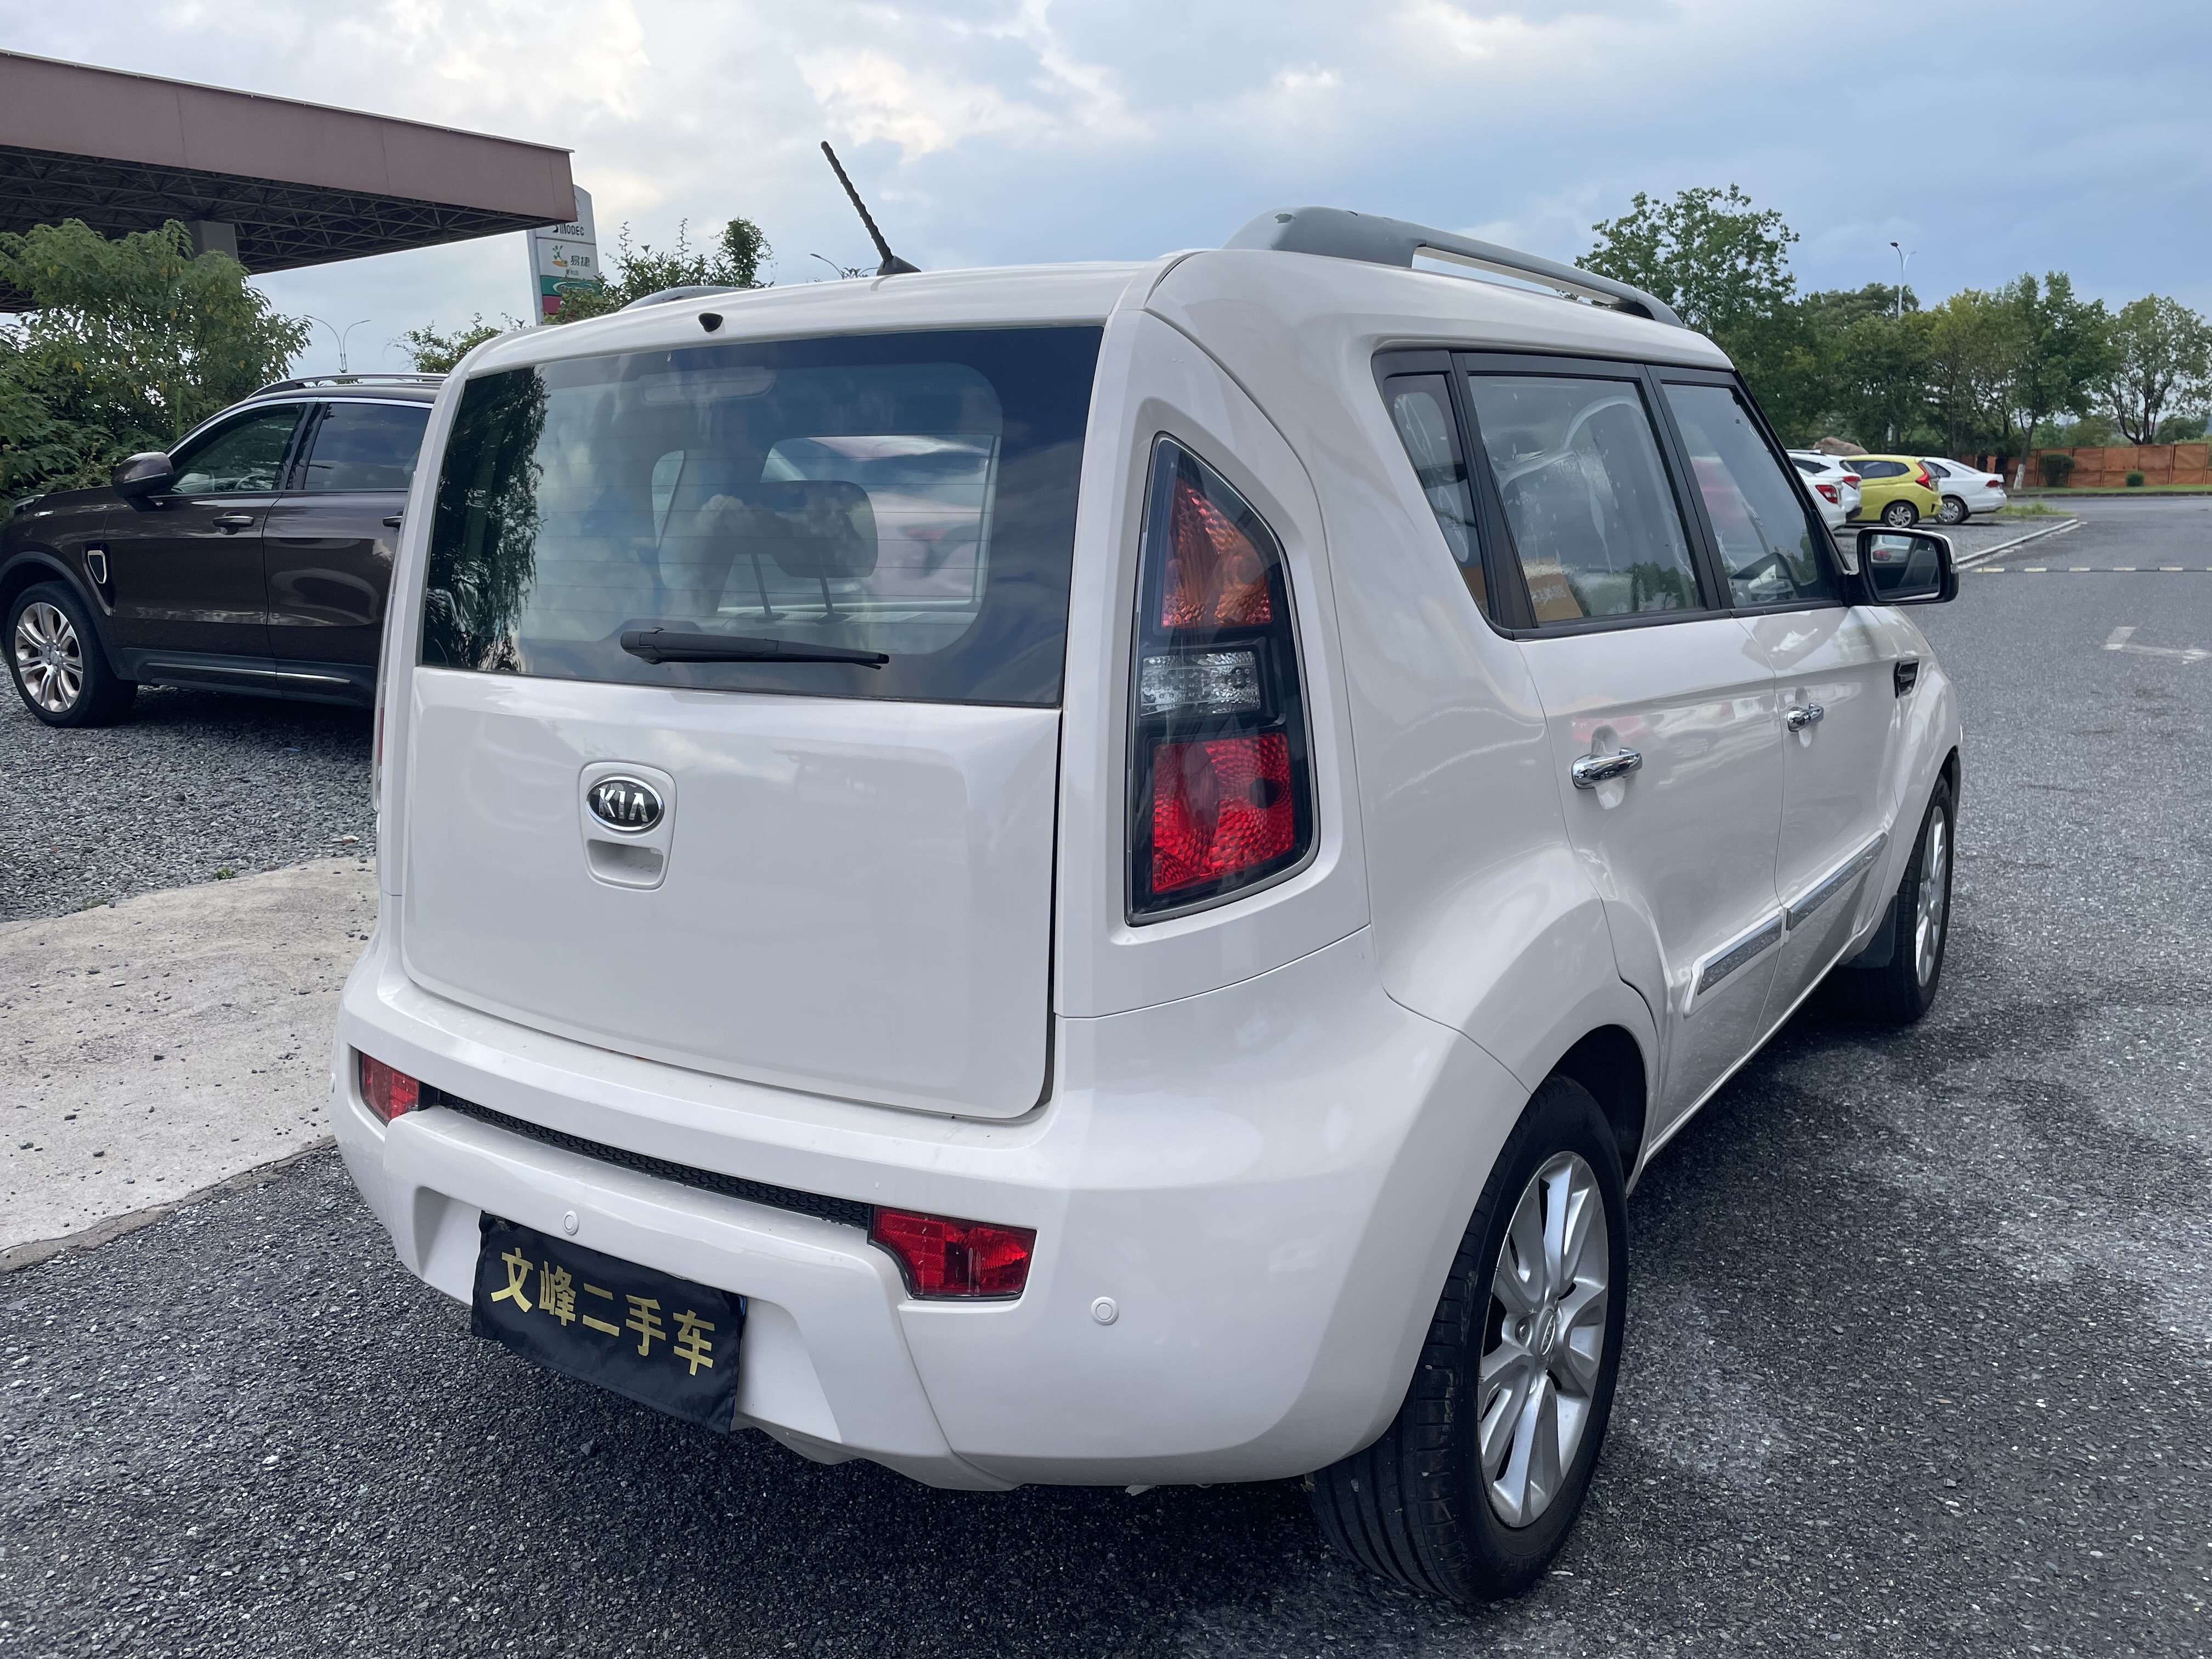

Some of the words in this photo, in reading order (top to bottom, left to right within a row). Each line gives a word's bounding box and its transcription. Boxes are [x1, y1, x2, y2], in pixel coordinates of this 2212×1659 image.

[570, 255, 591, 267] 易捷
[599, 788, 648, 822] KIA
[491, 1248, 715, 1376] 文峰二手车
